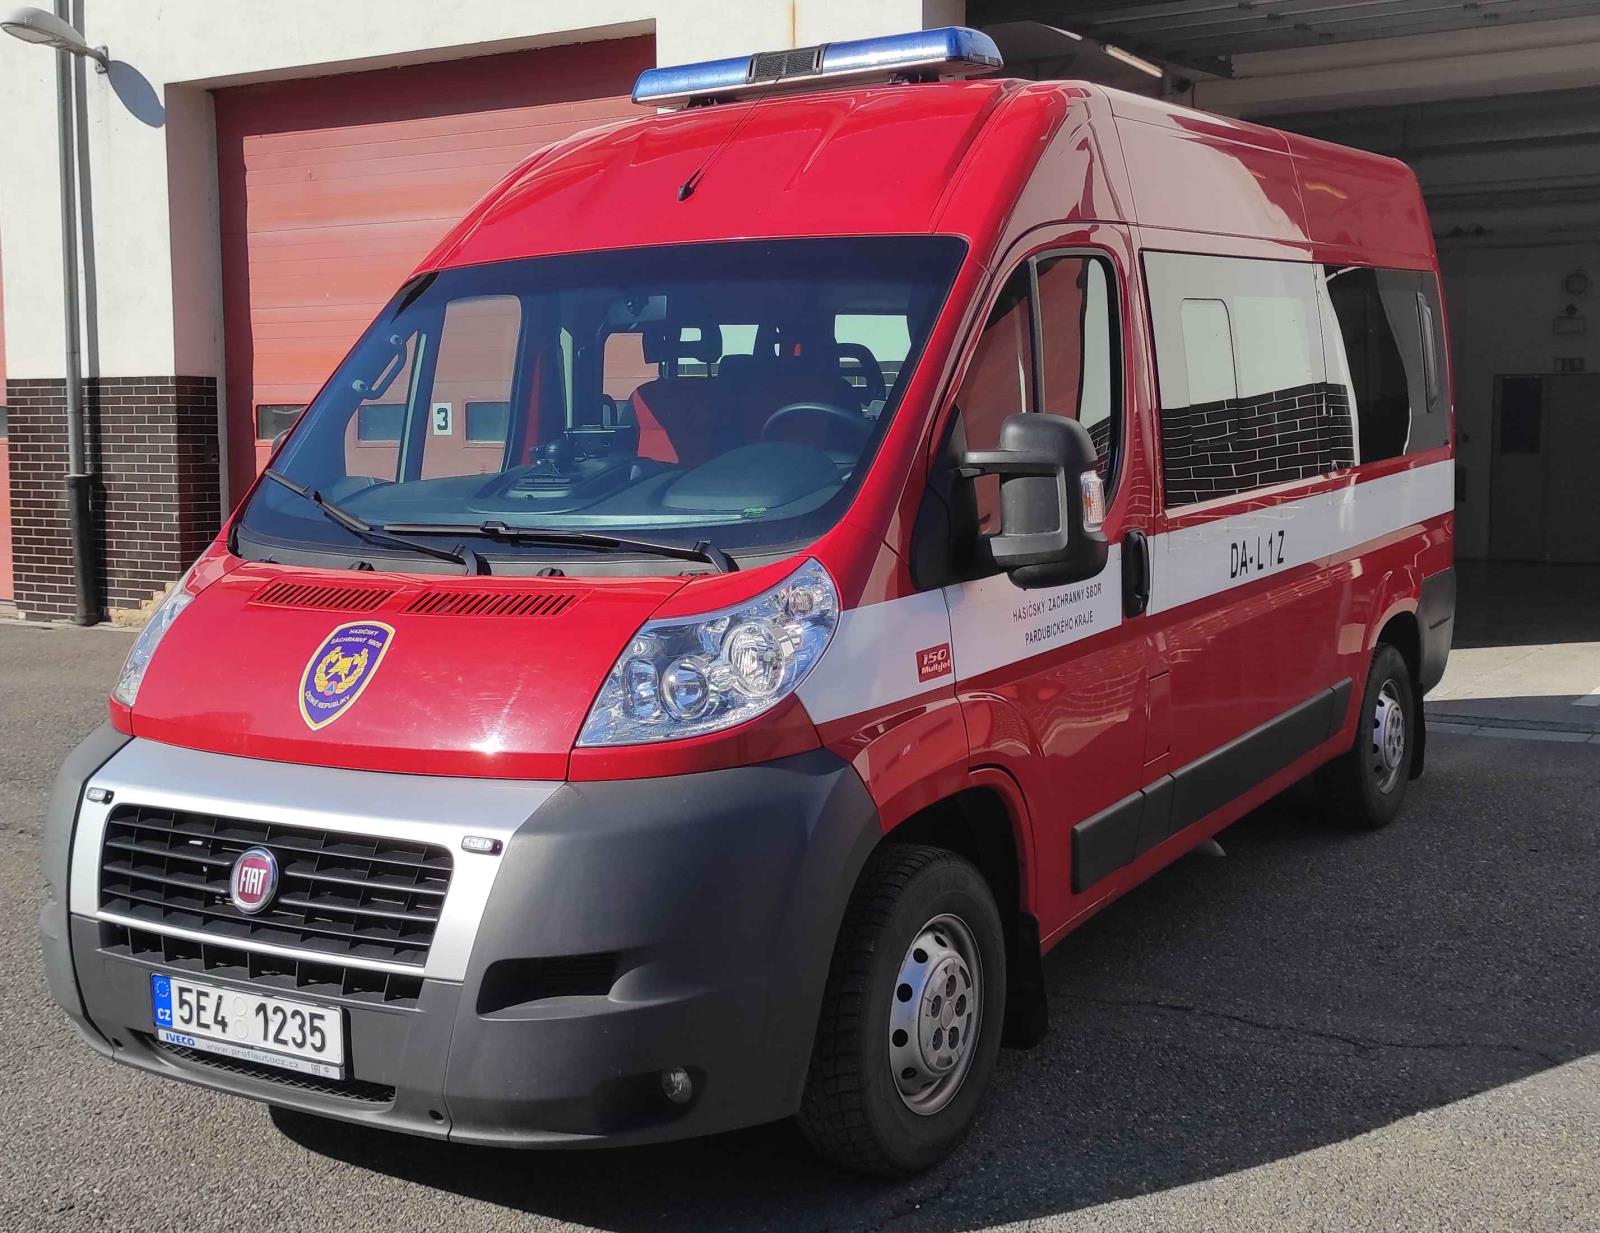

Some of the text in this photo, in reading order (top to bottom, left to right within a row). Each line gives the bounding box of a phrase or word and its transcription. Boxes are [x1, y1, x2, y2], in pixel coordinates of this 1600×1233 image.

[437, 407, 448, 430] 3
[1086, 583, 1102, 599] SBOR
[1025, 611, 1094, 646] PARDUBICKÉHO KRAJE
[922, 649, 947, 665] 150
[239, 866, 268, 896] FIAT
[157, 1007, 171, 1021] CZ
[178, 986, 327, 1053] 5E4 1235
[166, 1032, 195, 1046] IVECO
